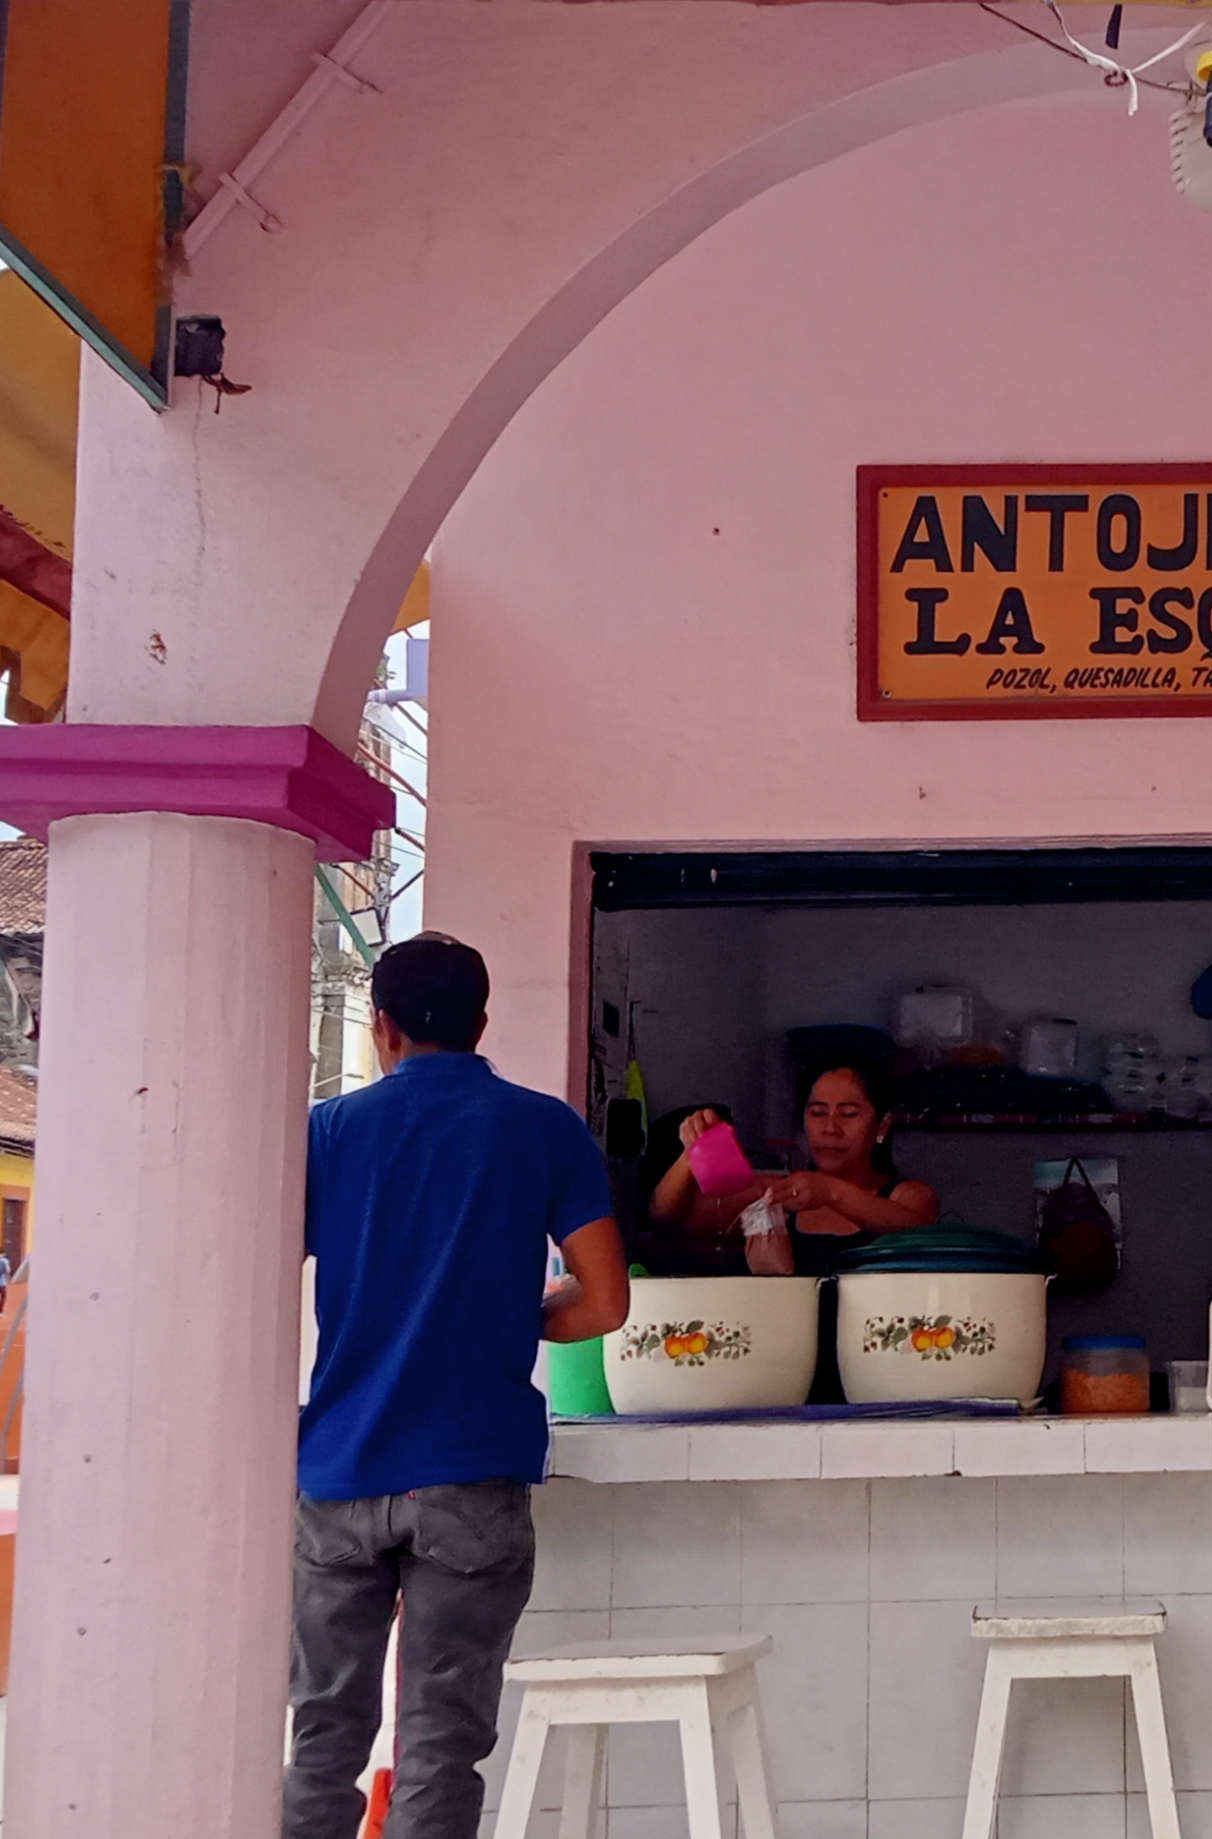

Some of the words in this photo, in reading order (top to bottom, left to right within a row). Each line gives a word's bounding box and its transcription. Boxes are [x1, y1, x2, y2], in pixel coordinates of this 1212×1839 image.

[903, 587, 1046, 656] LA
[986, 667, 1058, 694] POZOL,
[1063, 667, 1181, 692] QUESADILLA,
